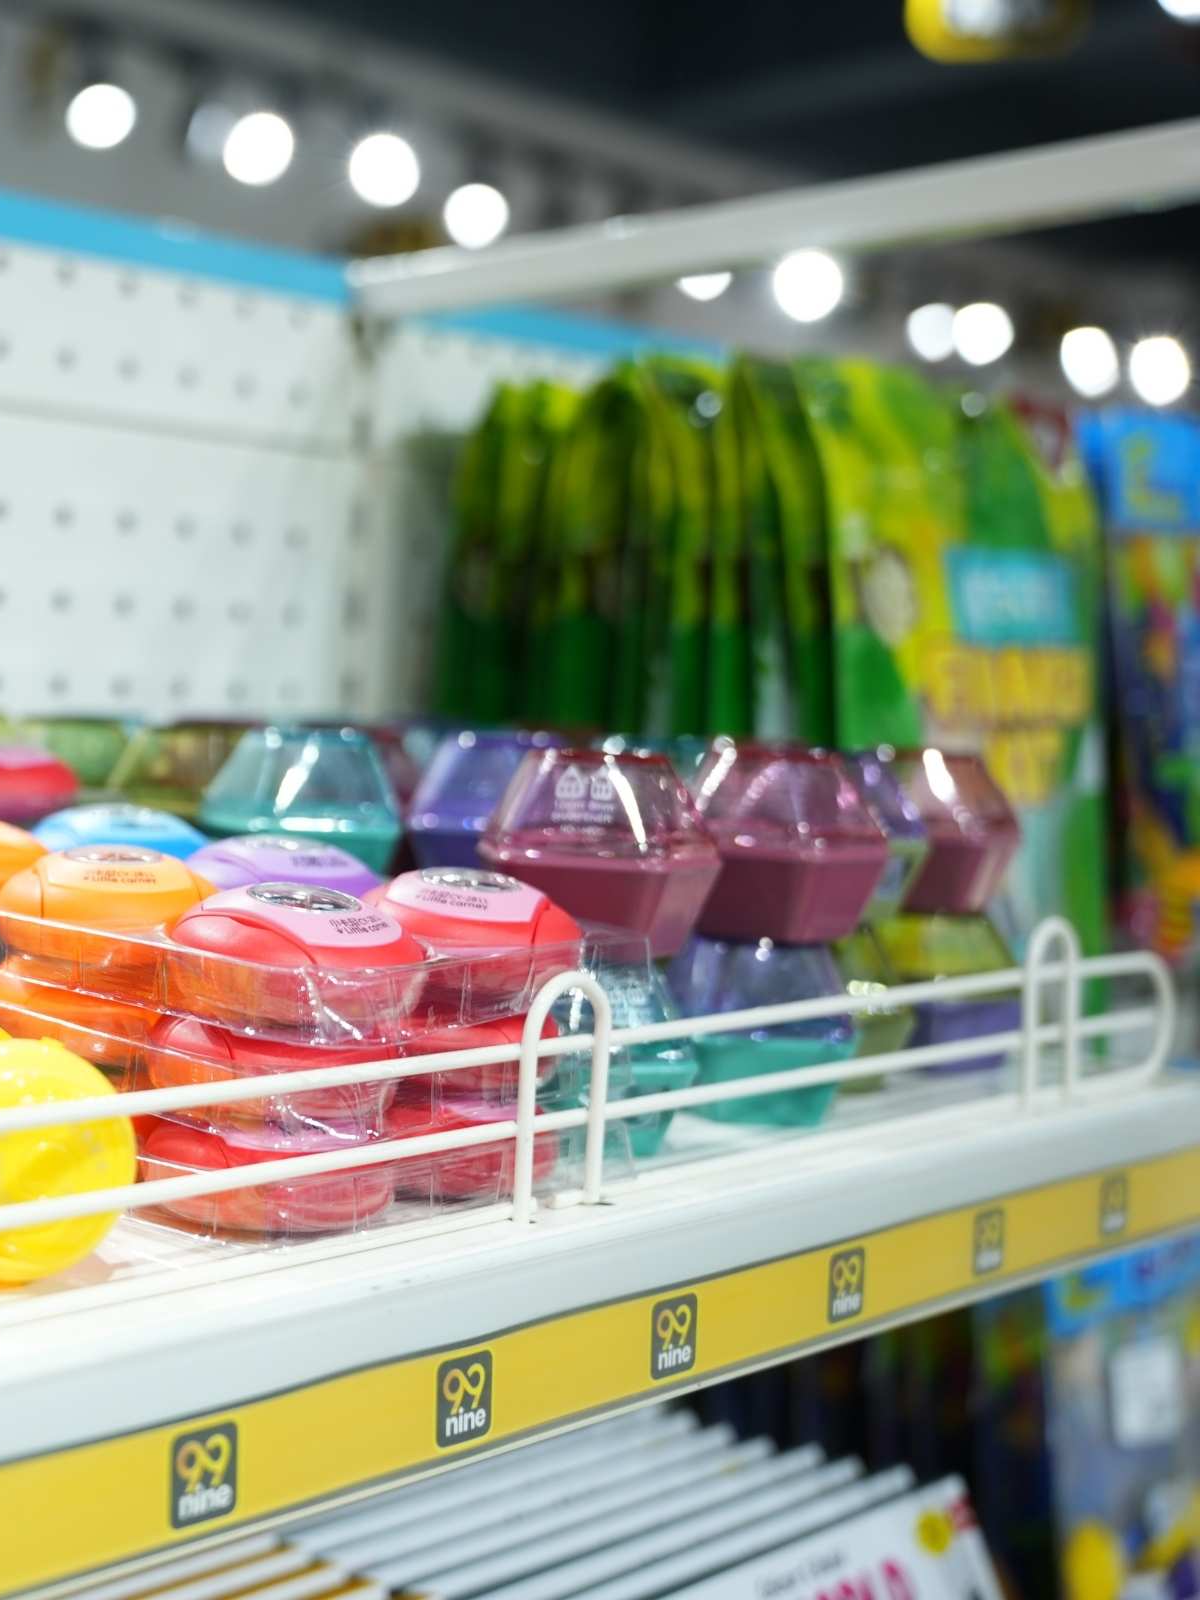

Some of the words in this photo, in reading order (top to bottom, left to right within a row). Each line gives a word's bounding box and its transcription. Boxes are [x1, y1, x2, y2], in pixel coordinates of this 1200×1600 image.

[656, 1304, 692, 1351] 99
[657, 1343, 692, 1371] nine
[443, 1362, 485, 1416] 99
[445, 1406, 487, 1437] nine
[176, 1433, 231, 1495] 99
[178, 1482, 233, 1521] nine
